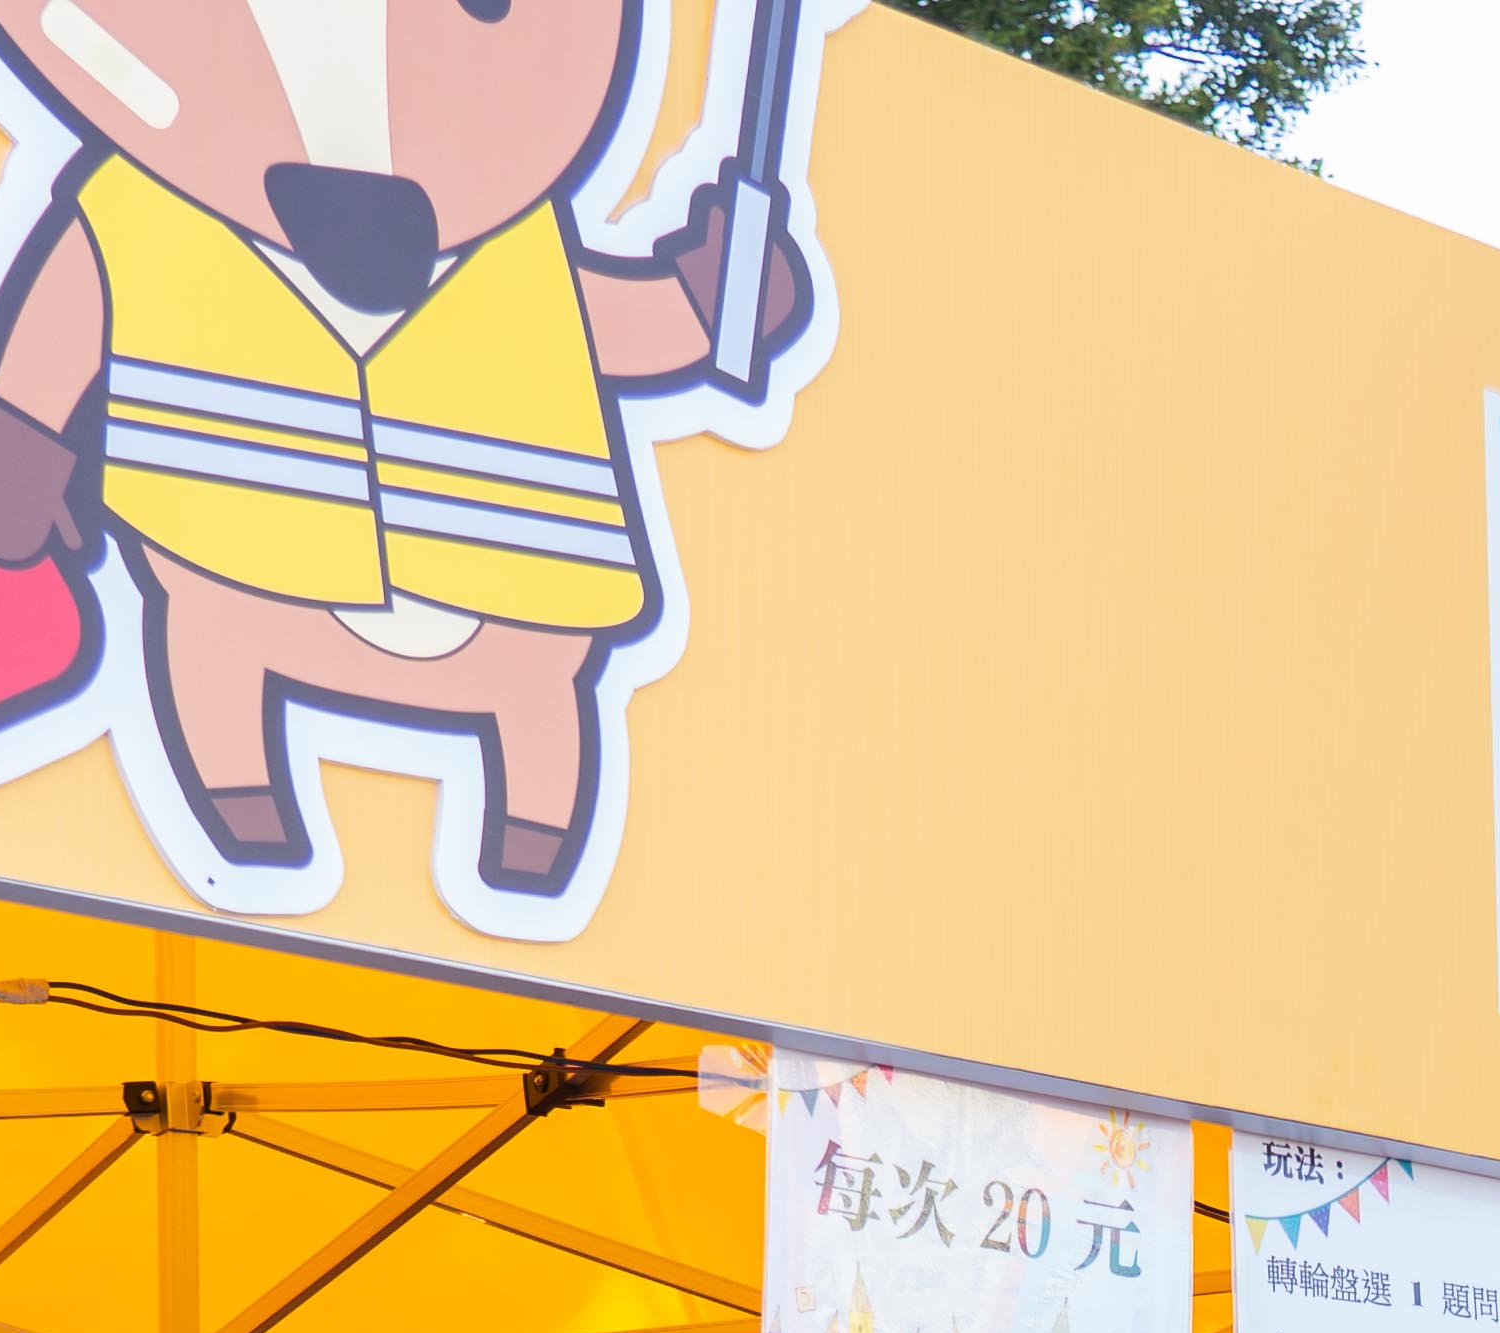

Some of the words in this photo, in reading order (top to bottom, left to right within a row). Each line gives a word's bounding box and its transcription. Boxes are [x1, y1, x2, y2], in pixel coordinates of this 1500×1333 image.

[815, 1139, 957, 1250] 每次
[981, 1179, 1052, 1260] 20
[1075, 1199, 1143, 1280] 元
[1266, 1255, 1392, 1309] 轉輪盤選
